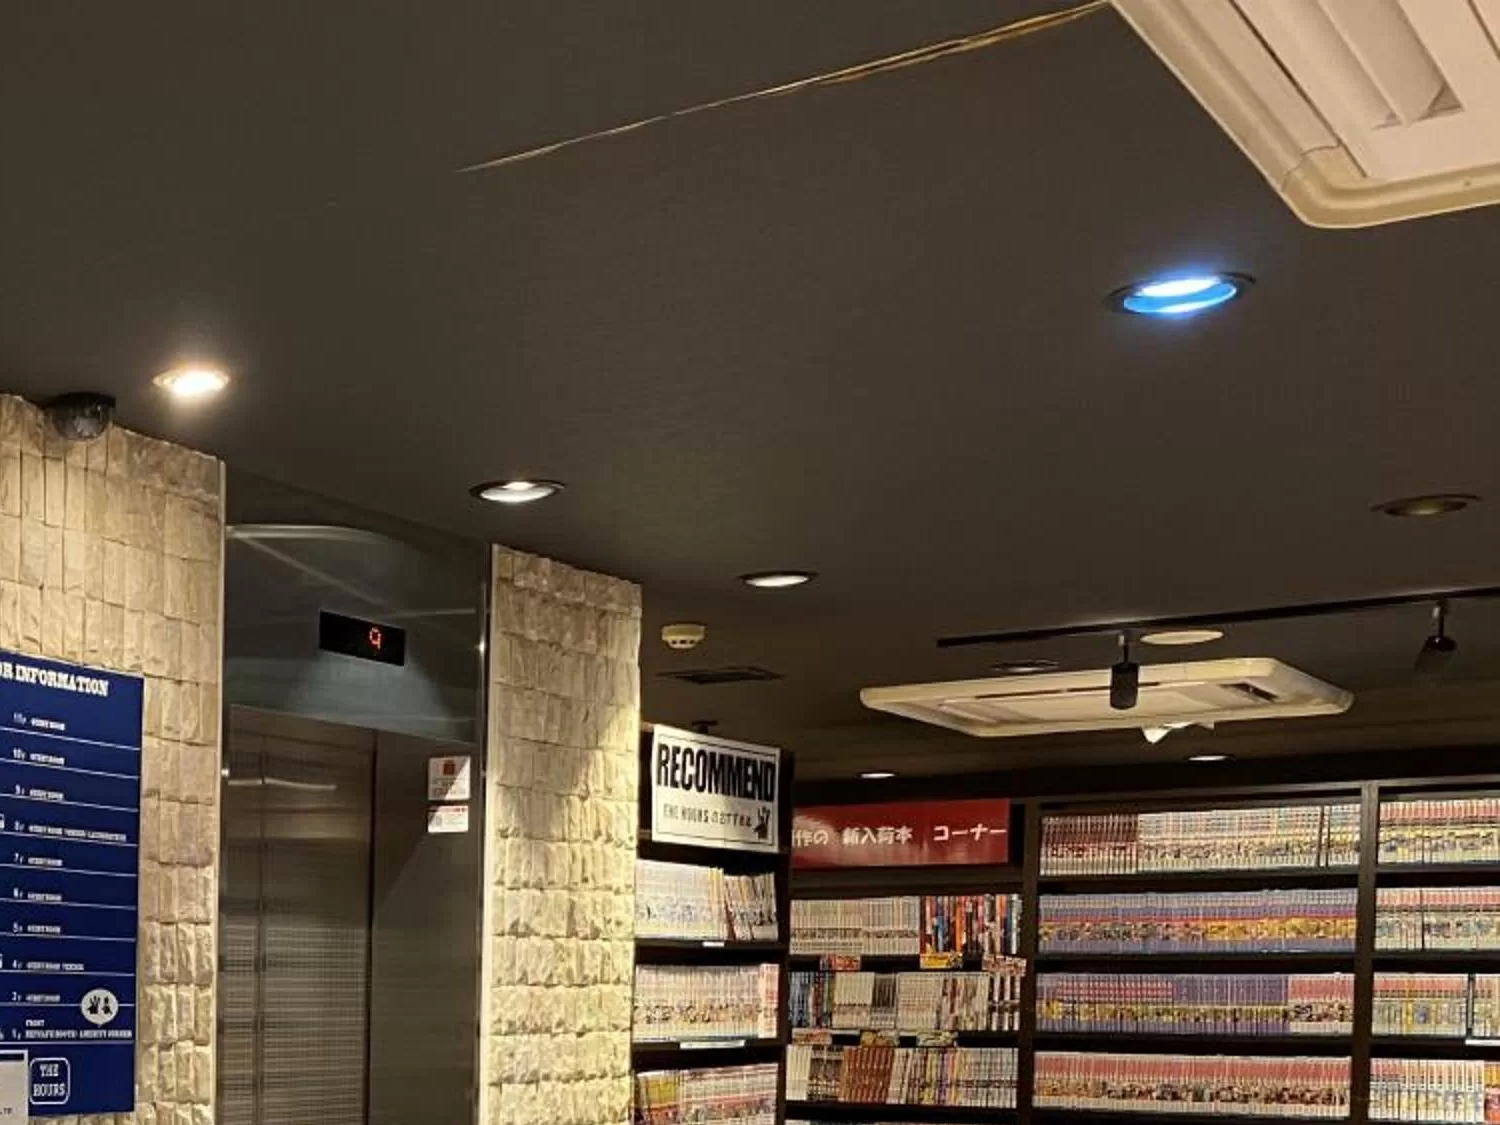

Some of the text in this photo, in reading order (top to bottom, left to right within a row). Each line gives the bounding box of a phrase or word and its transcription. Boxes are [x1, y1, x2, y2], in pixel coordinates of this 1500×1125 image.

[16, 664, 109, 697] INFORMATION
[657, 743, 776, 802] RECOMMEND
[842, 825, 912, 845] 新入荷本
[934, 824, 1007, 842] コーナー
[39, 1063, 60, 1077] THE
[33, 1083, 66, 1098] HOURS
